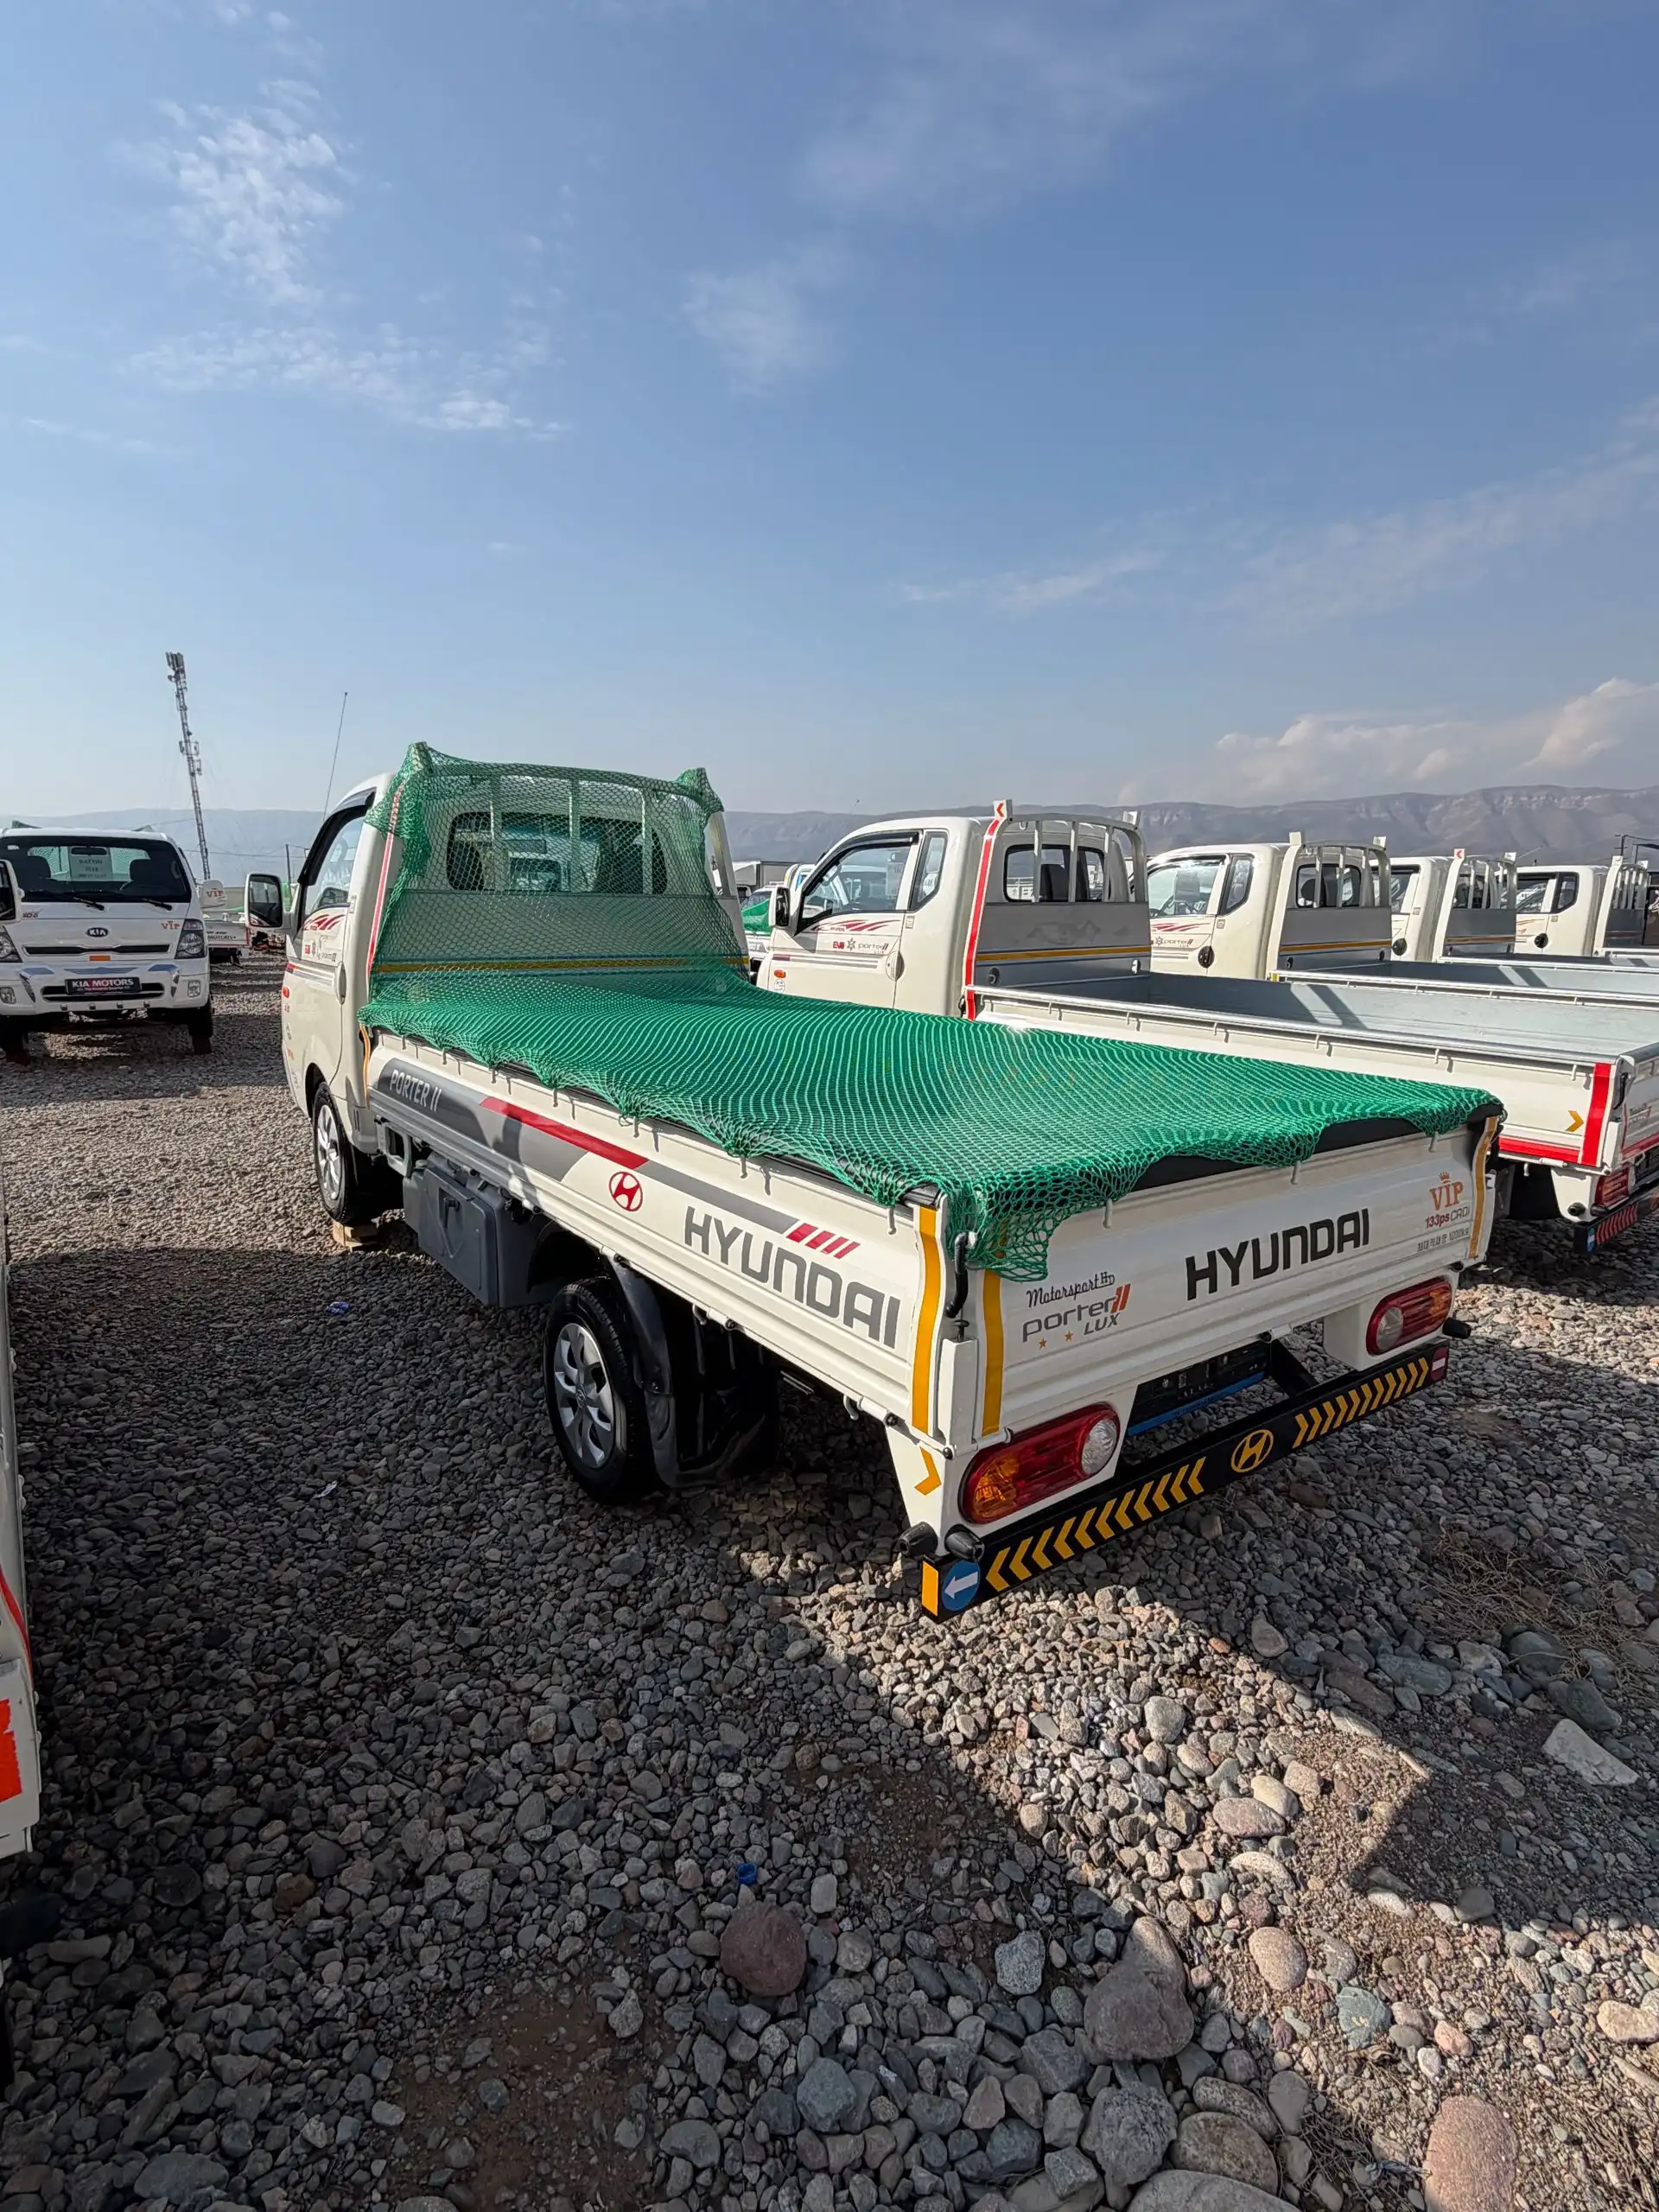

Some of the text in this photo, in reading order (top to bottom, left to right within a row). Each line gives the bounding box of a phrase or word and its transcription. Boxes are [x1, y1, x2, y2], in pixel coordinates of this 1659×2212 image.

[89, 928, 107, 937] KIA
[92, 978, 134, 988] MOTORS
[390, 1069, 442, 1112] PORTER II
[1429, 1181, 1464, 1211] VIP
[1185, 1208, 1370, 1301] HYUNDAI
[684, 1205, 900, 1350] HYUNDAI
[1026, 1273, 1101, 1308] Motorsport
[1084, 1313, 1121, 1336] LUX
